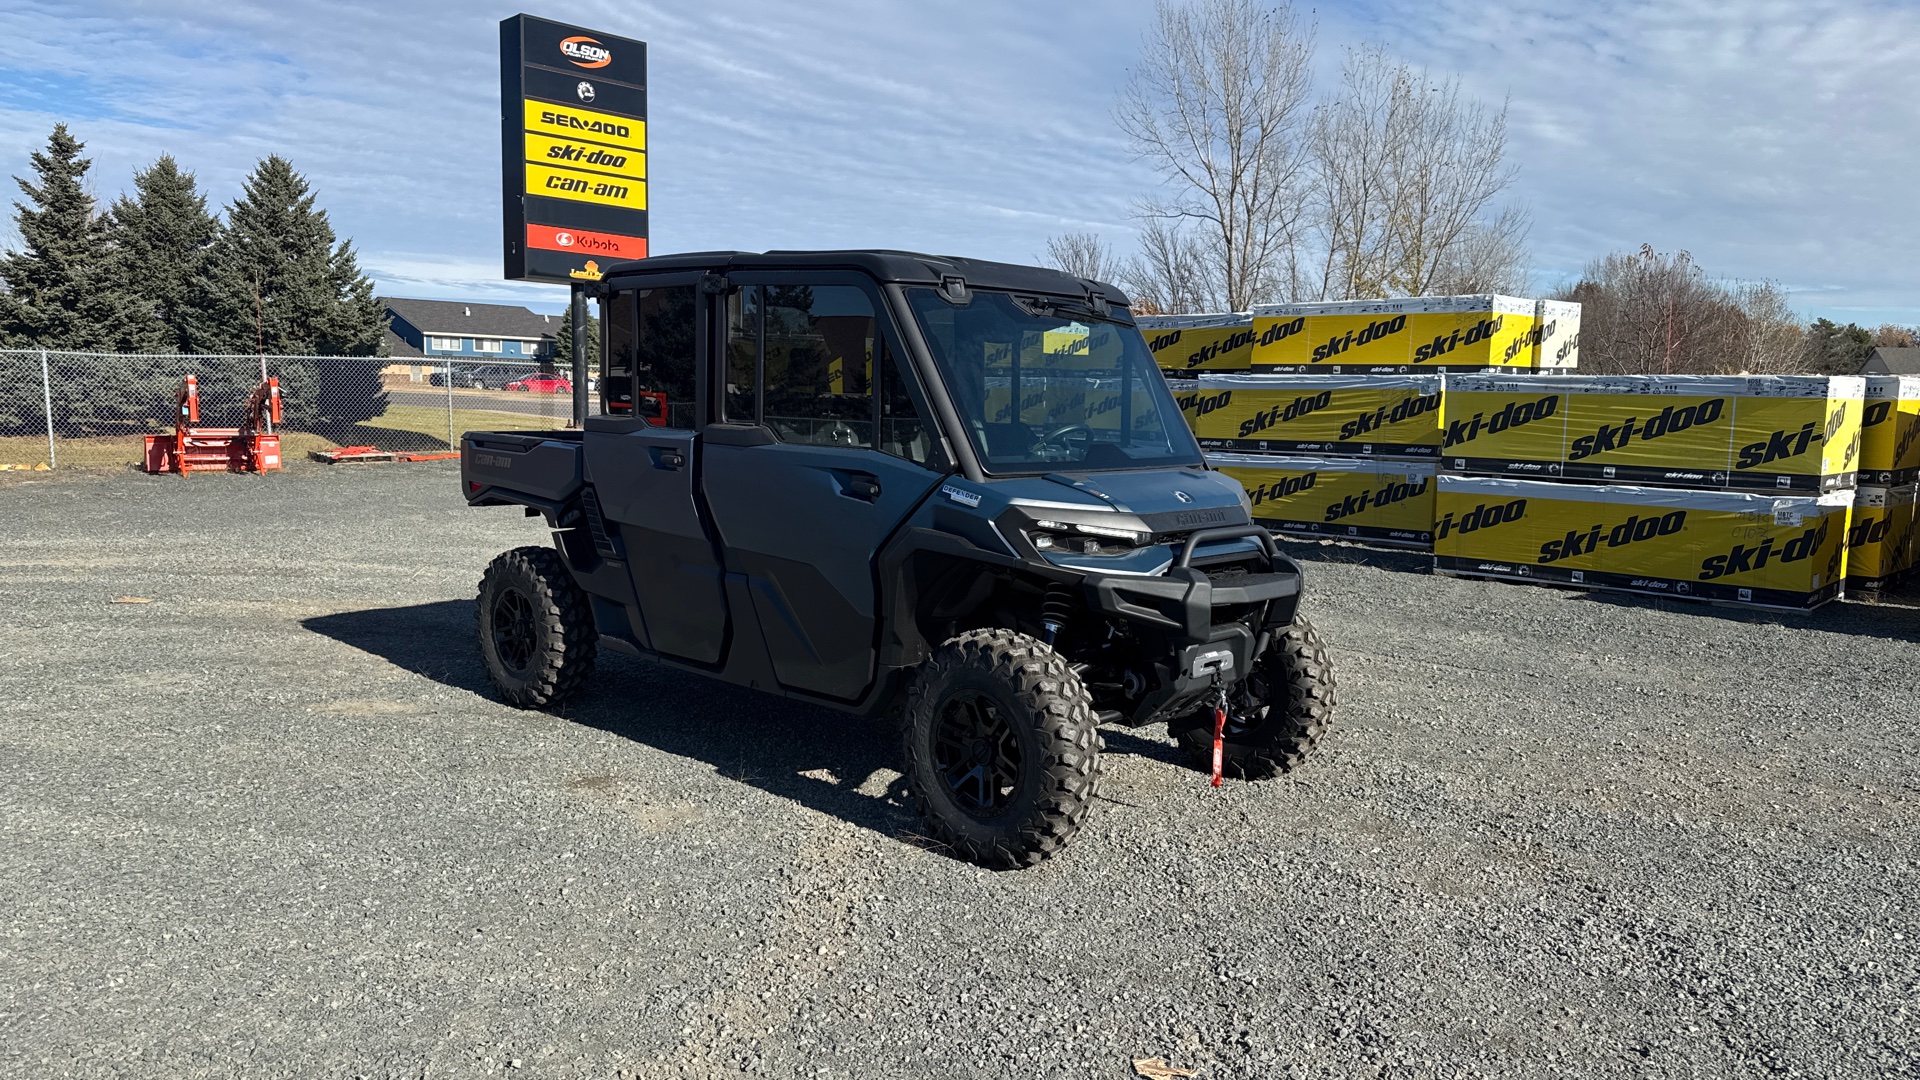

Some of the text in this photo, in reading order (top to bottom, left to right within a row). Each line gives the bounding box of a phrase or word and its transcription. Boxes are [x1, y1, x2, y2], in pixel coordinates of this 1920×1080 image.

[562, 41, 610, 60] OLSON
[546, 144, 627, 168] ski-doo
[545, 175, 629, 199] can-am
[576, 235, 619, 252] Kubota
[1311, 314, 1407, 364] ski-doo
[1413, 314, 1504, 364] ski-doo
[1238, 390, 1332, 438] ski-doo
[1338, 391, 1443, 441] ski-doo
[1568, 398, 1724, 461] ski-doo
[1735, 401, 1847, 470] ski-doo
[474, 452, 512, 469] can-am
[1507, 462, 1542, 471] ski-doo
[1664, 472, 1704, 481] ski-doo
[943, 485, 980, 502] DEFENDER
[1324, 476, 1429, 522] ski-doo
[1176, 510, 1226, 526] can-am
[1434, 499, 1528, 542] i-doo
[1537, 510, 1688, 564] ski-doo
[1698, 516, 1830, 581] ski-doo
[1478, 563, 1512, 572] ski-doo
[1630, 579, 1669, 589] ski-doo
